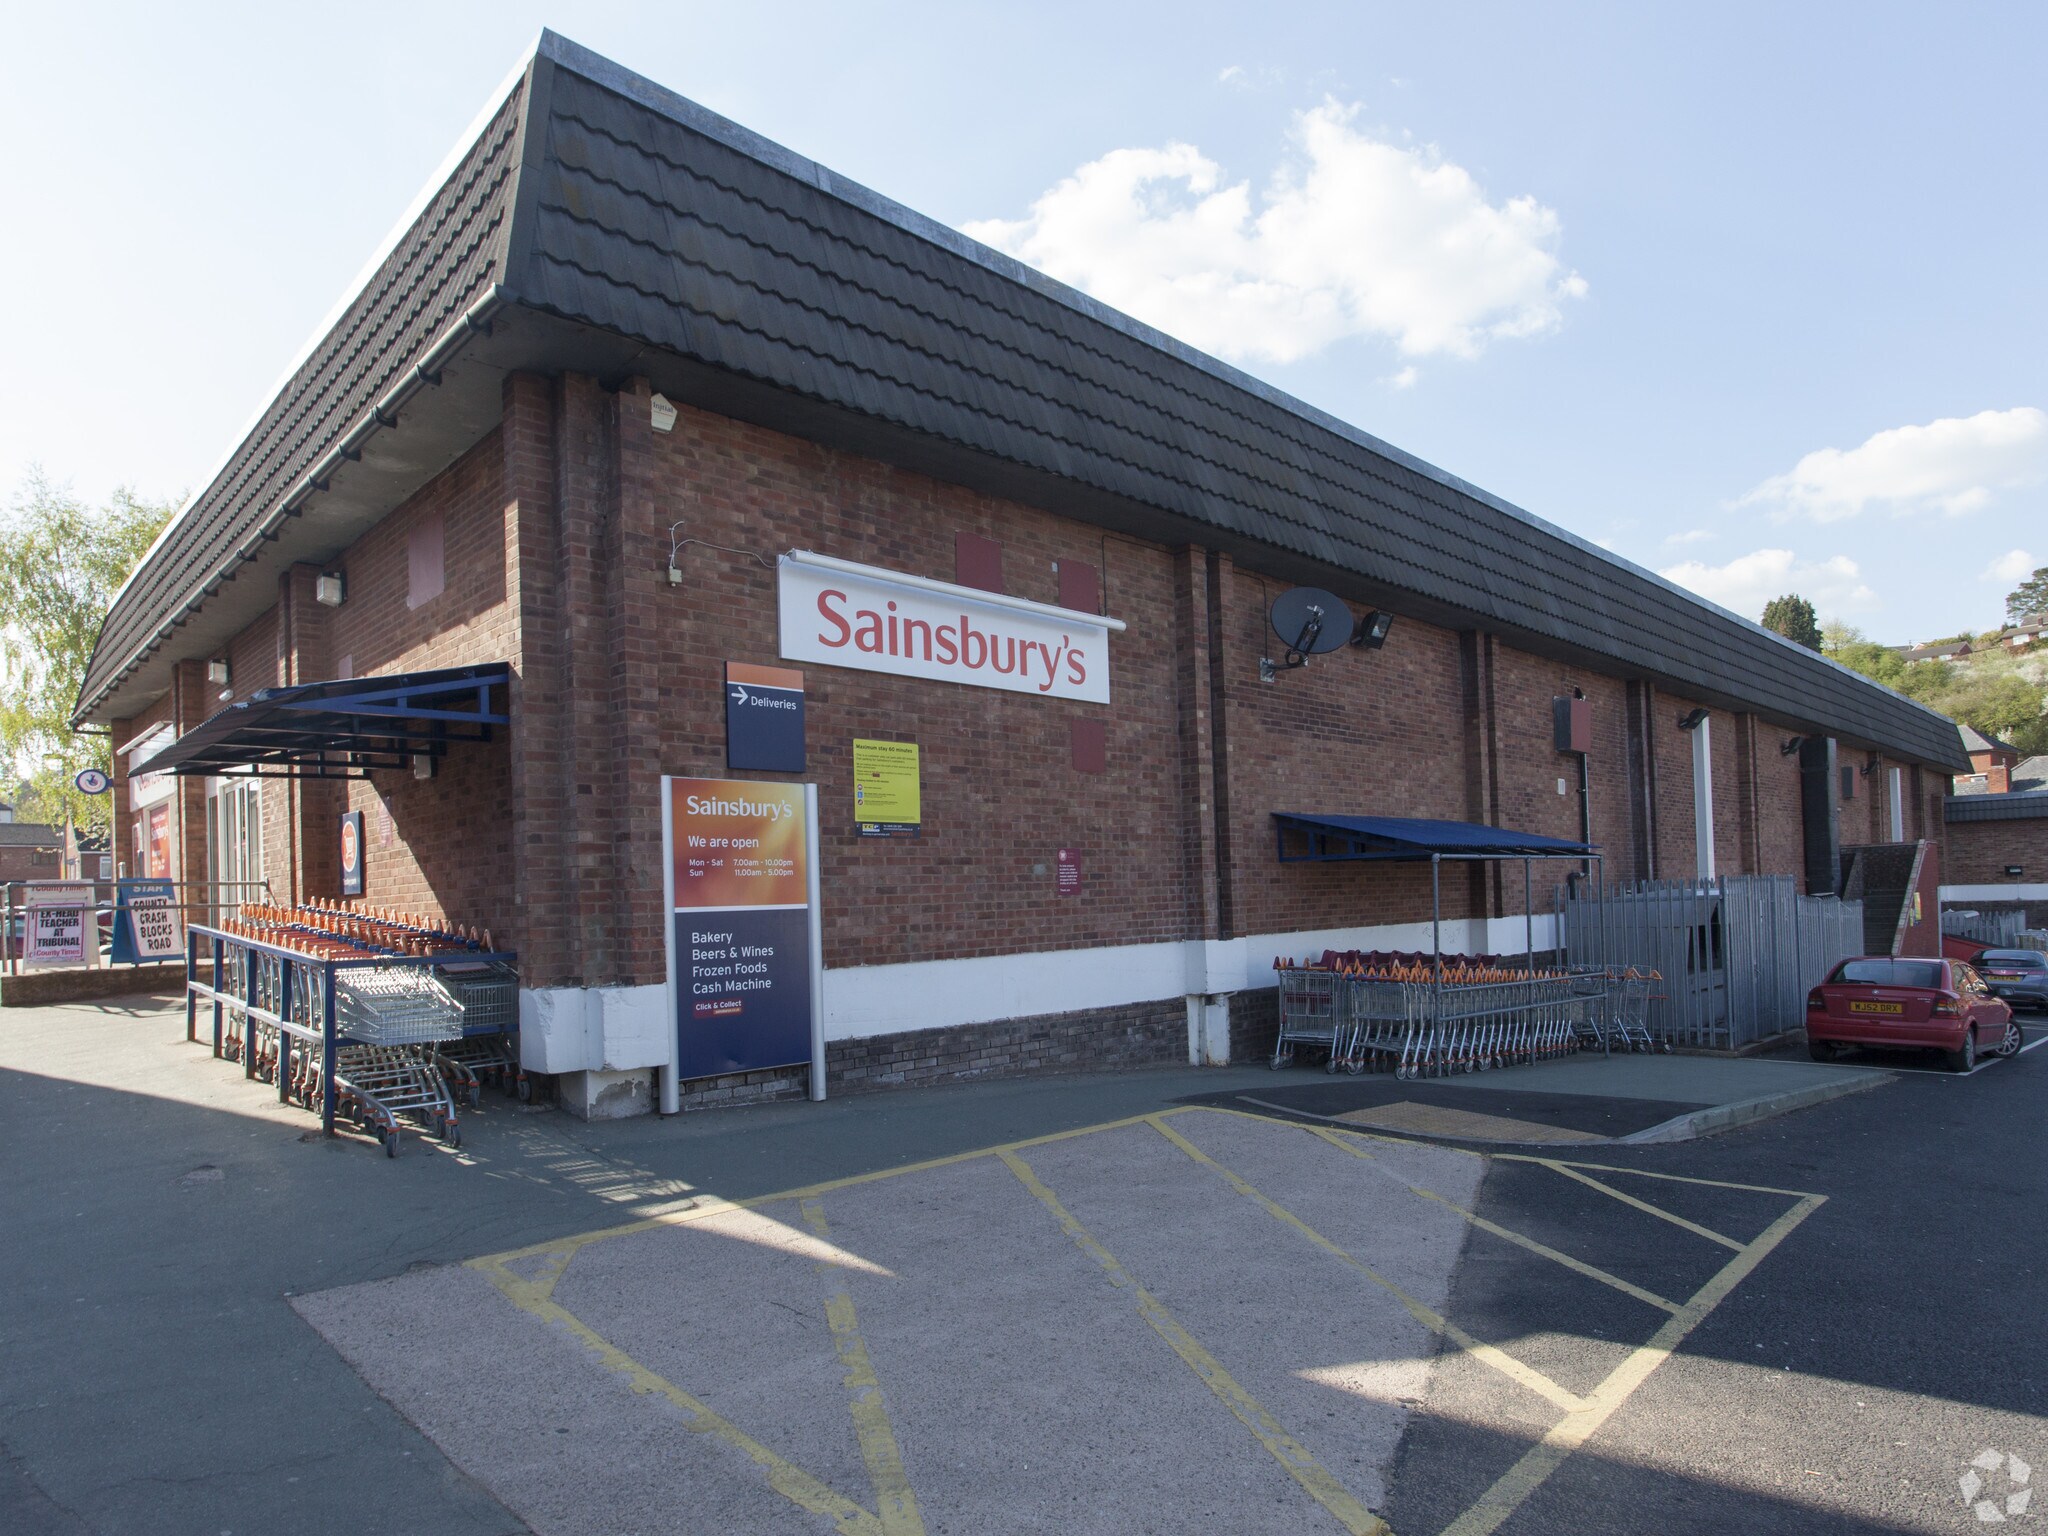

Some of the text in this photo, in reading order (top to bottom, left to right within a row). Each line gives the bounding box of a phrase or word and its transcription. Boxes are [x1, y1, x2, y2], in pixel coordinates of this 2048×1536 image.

[817, 589, 1086, 692] Sainsbury's
[751, 696, 797, 710] Deliveries
[686, 795, 793, 821] Sainsbury's
[688, 835, 759, 850] We are open
[689, 859, 705, 867] Mon
[711, 859, 723, 867] Sat
[733, 859, 759, 867] 7.00am
[765, 859, 793, 868] 10.00pm
[689, 869, 704, 877] Sun
[734, 869, 762, 877] 11.00am
[768, 869, 794, 878] 5.00pm
[133, 898, 168, 912] COUNTY
[40, 910, 79, 919] EX-HEAD
[140, 911, 168, 925] CRASH
[40, 918, 79, 928] TEACHER
[53, 928, 65, 937] AT
[140, 923, 173, 938] BLOCKS
[37, 937, 80, 947] TRIBUNAL
[147, 937, 172, 950] ROAD
[691, 932, 733, 944] Bakery
[36, 948, 80, 958] County Times
[692, 946, 774, 961] Beers & Wines
[693, 962, 768, 978] Frozen Foods
[693, 978, 772, 994] Cash Machine
[695, 1003, 712, 1011] Click
[719, 1000, 742, 1008] Collect
